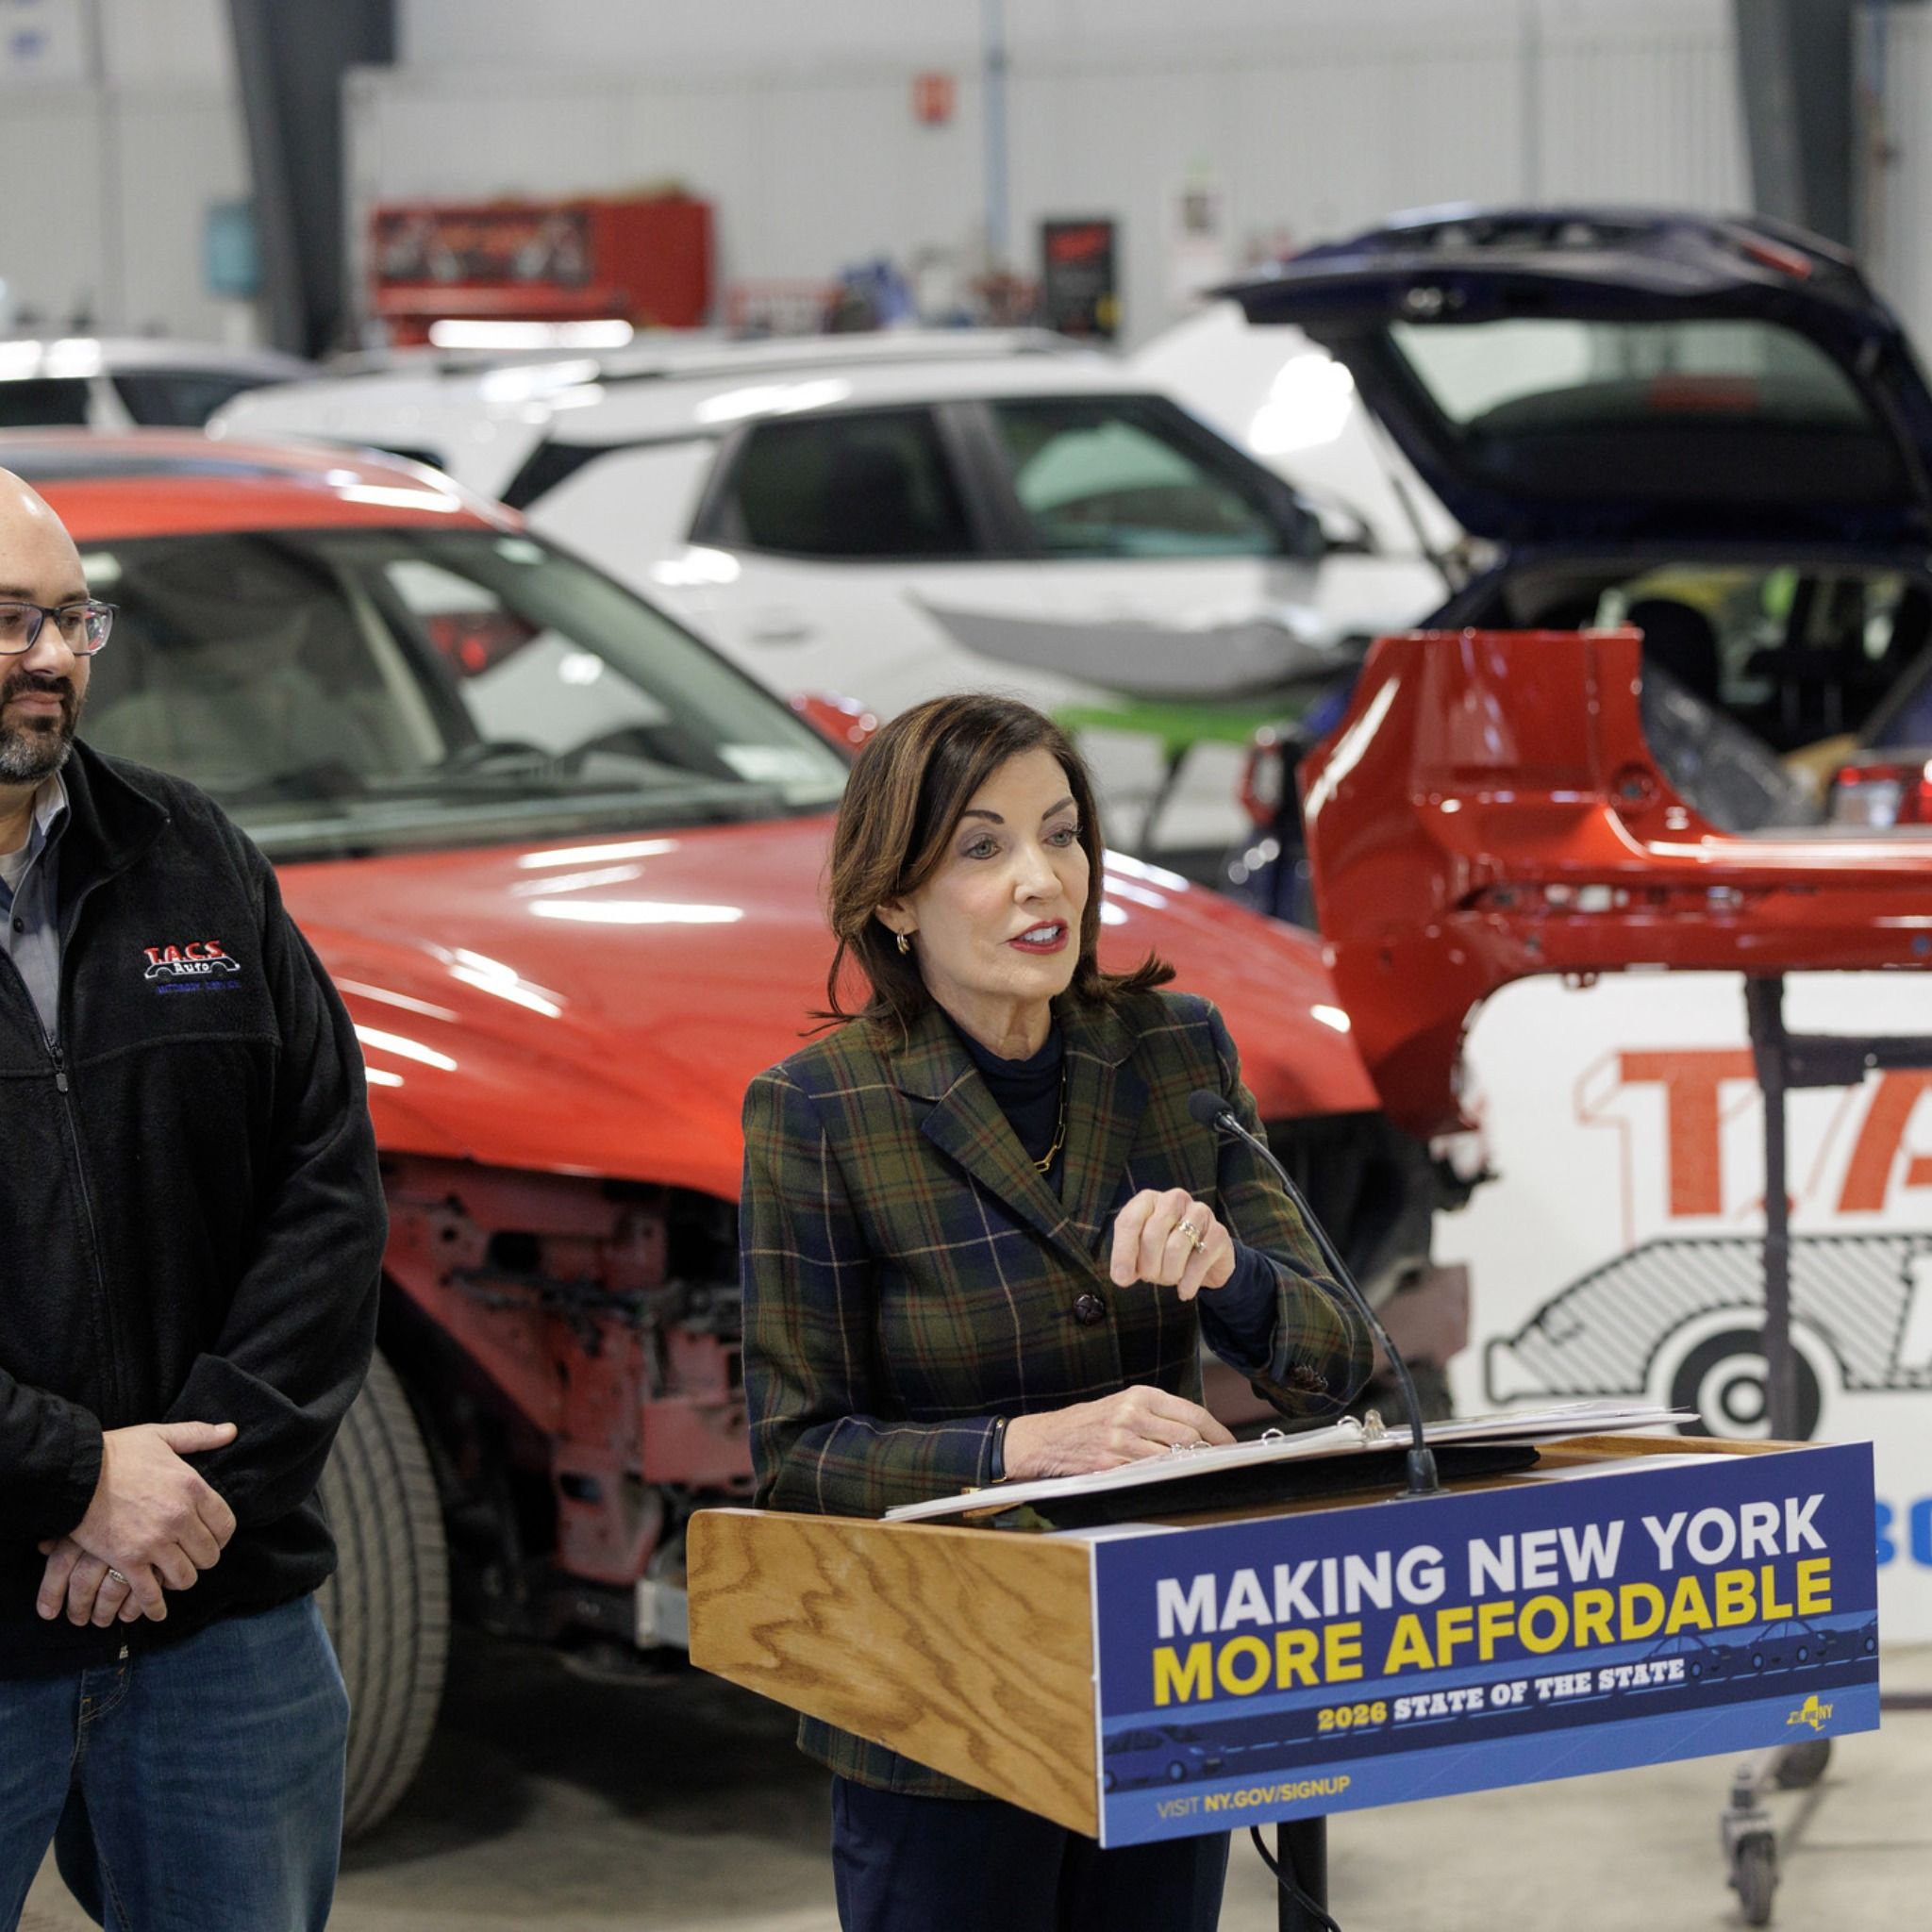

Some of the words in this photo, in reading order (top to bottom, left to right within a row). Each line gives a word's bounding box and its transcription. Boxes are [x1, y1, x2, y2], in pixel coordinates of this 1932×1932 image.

[1157, 1545, 1446, 1640] MAKING
[1468, 1520, 1624, 1597] NEW
[1641, 1493, 1827, 1572] YORK
[1153, 1621, 1363, 1707] MORE
[1383, 1557, 1832, 1675] AFFORDABLE
[1318, 1701, 1388, 1731] 2026
[1393, 1687, 1484, 1722] STATE
[1490, 1681, 1527, 1707] OF
[1534, 1669, 1592, 1700] THE
[1598, 1658, 1685, 1691] STATE
[1157, 1796, 1200, 1819] VISIT
[1204, 1775, 1351, 1812] NY.GOV/SIGNUP
